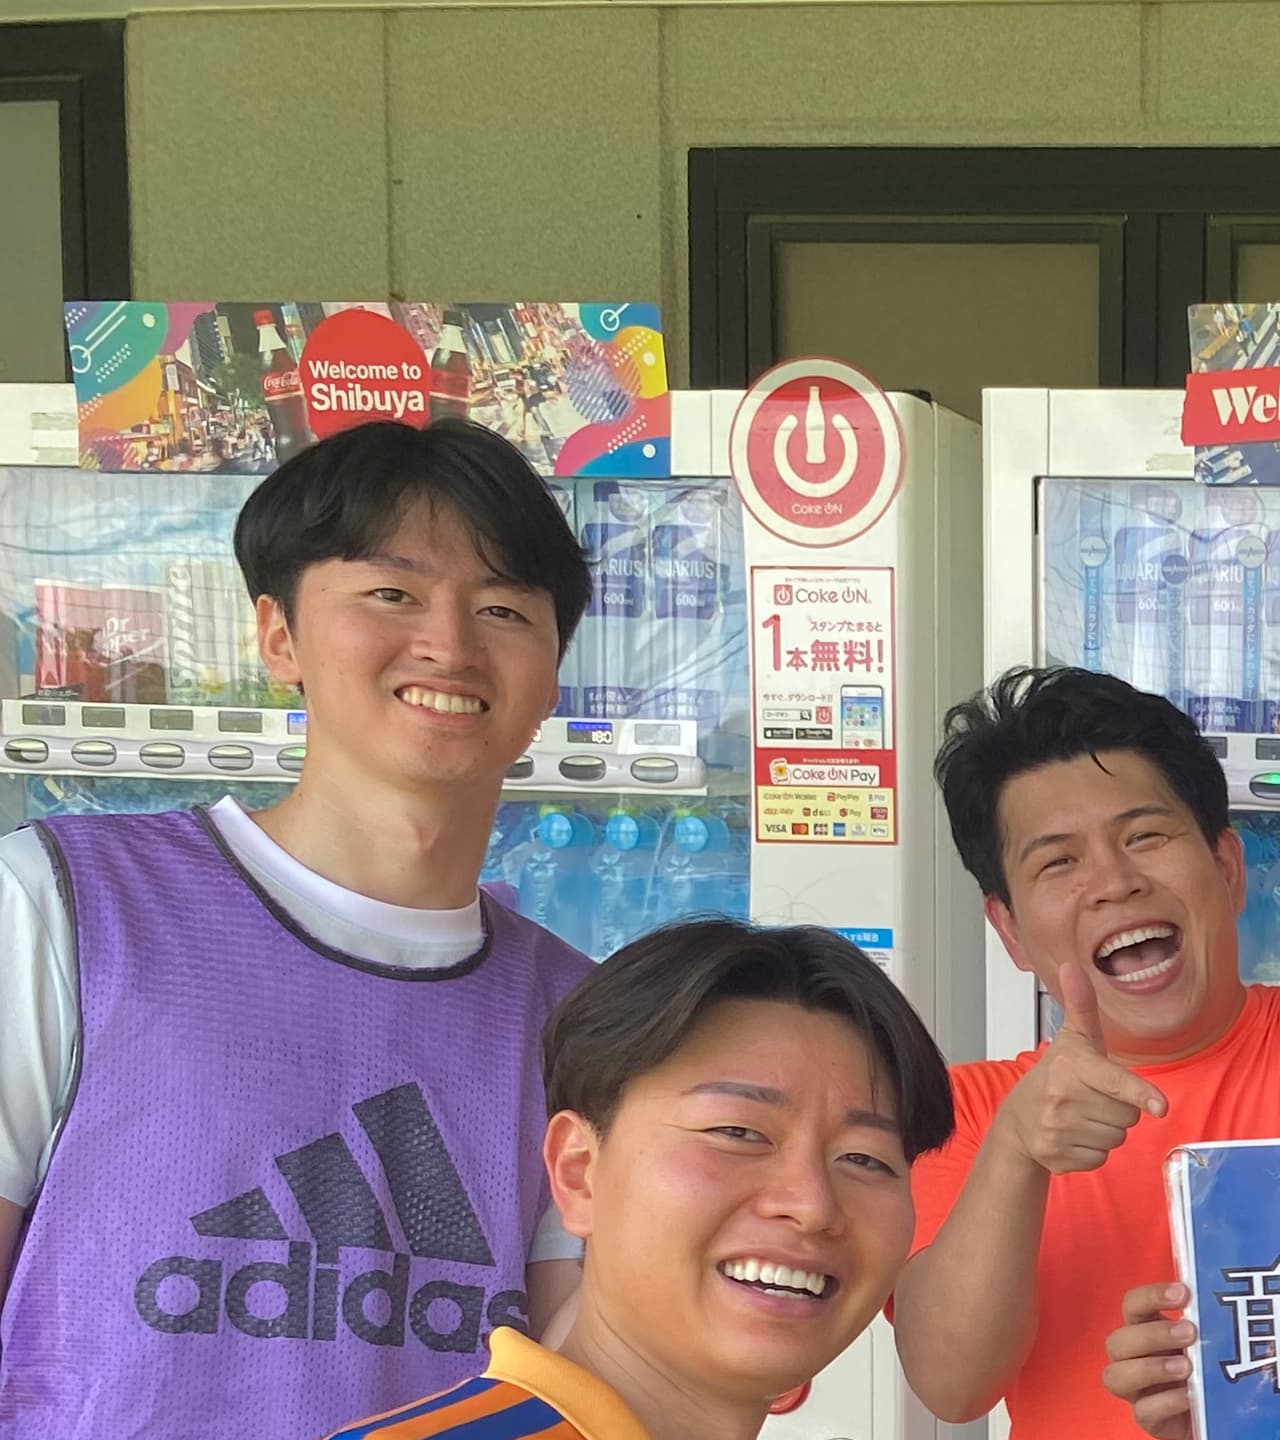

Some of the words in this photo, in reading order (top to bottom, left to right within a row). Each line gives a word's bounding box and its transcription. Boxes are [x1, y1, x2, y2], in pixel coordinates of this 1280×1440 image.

[308, 360, 398, 380] Welcome
[401, 362, 422, 380] to
[311, 382, 425, 418] Shibuya
[791, 504, 822, 515] Coke
[795, 588, 838, 603] Coke
[810, 621, 884, 632] スタンプたまると
[792, 768, 826, 781] Coke
[851, 770, 876, 784] Pay
[765, 824, 787, 833] VISA
[134, 1240, 530, 1354] adidas
